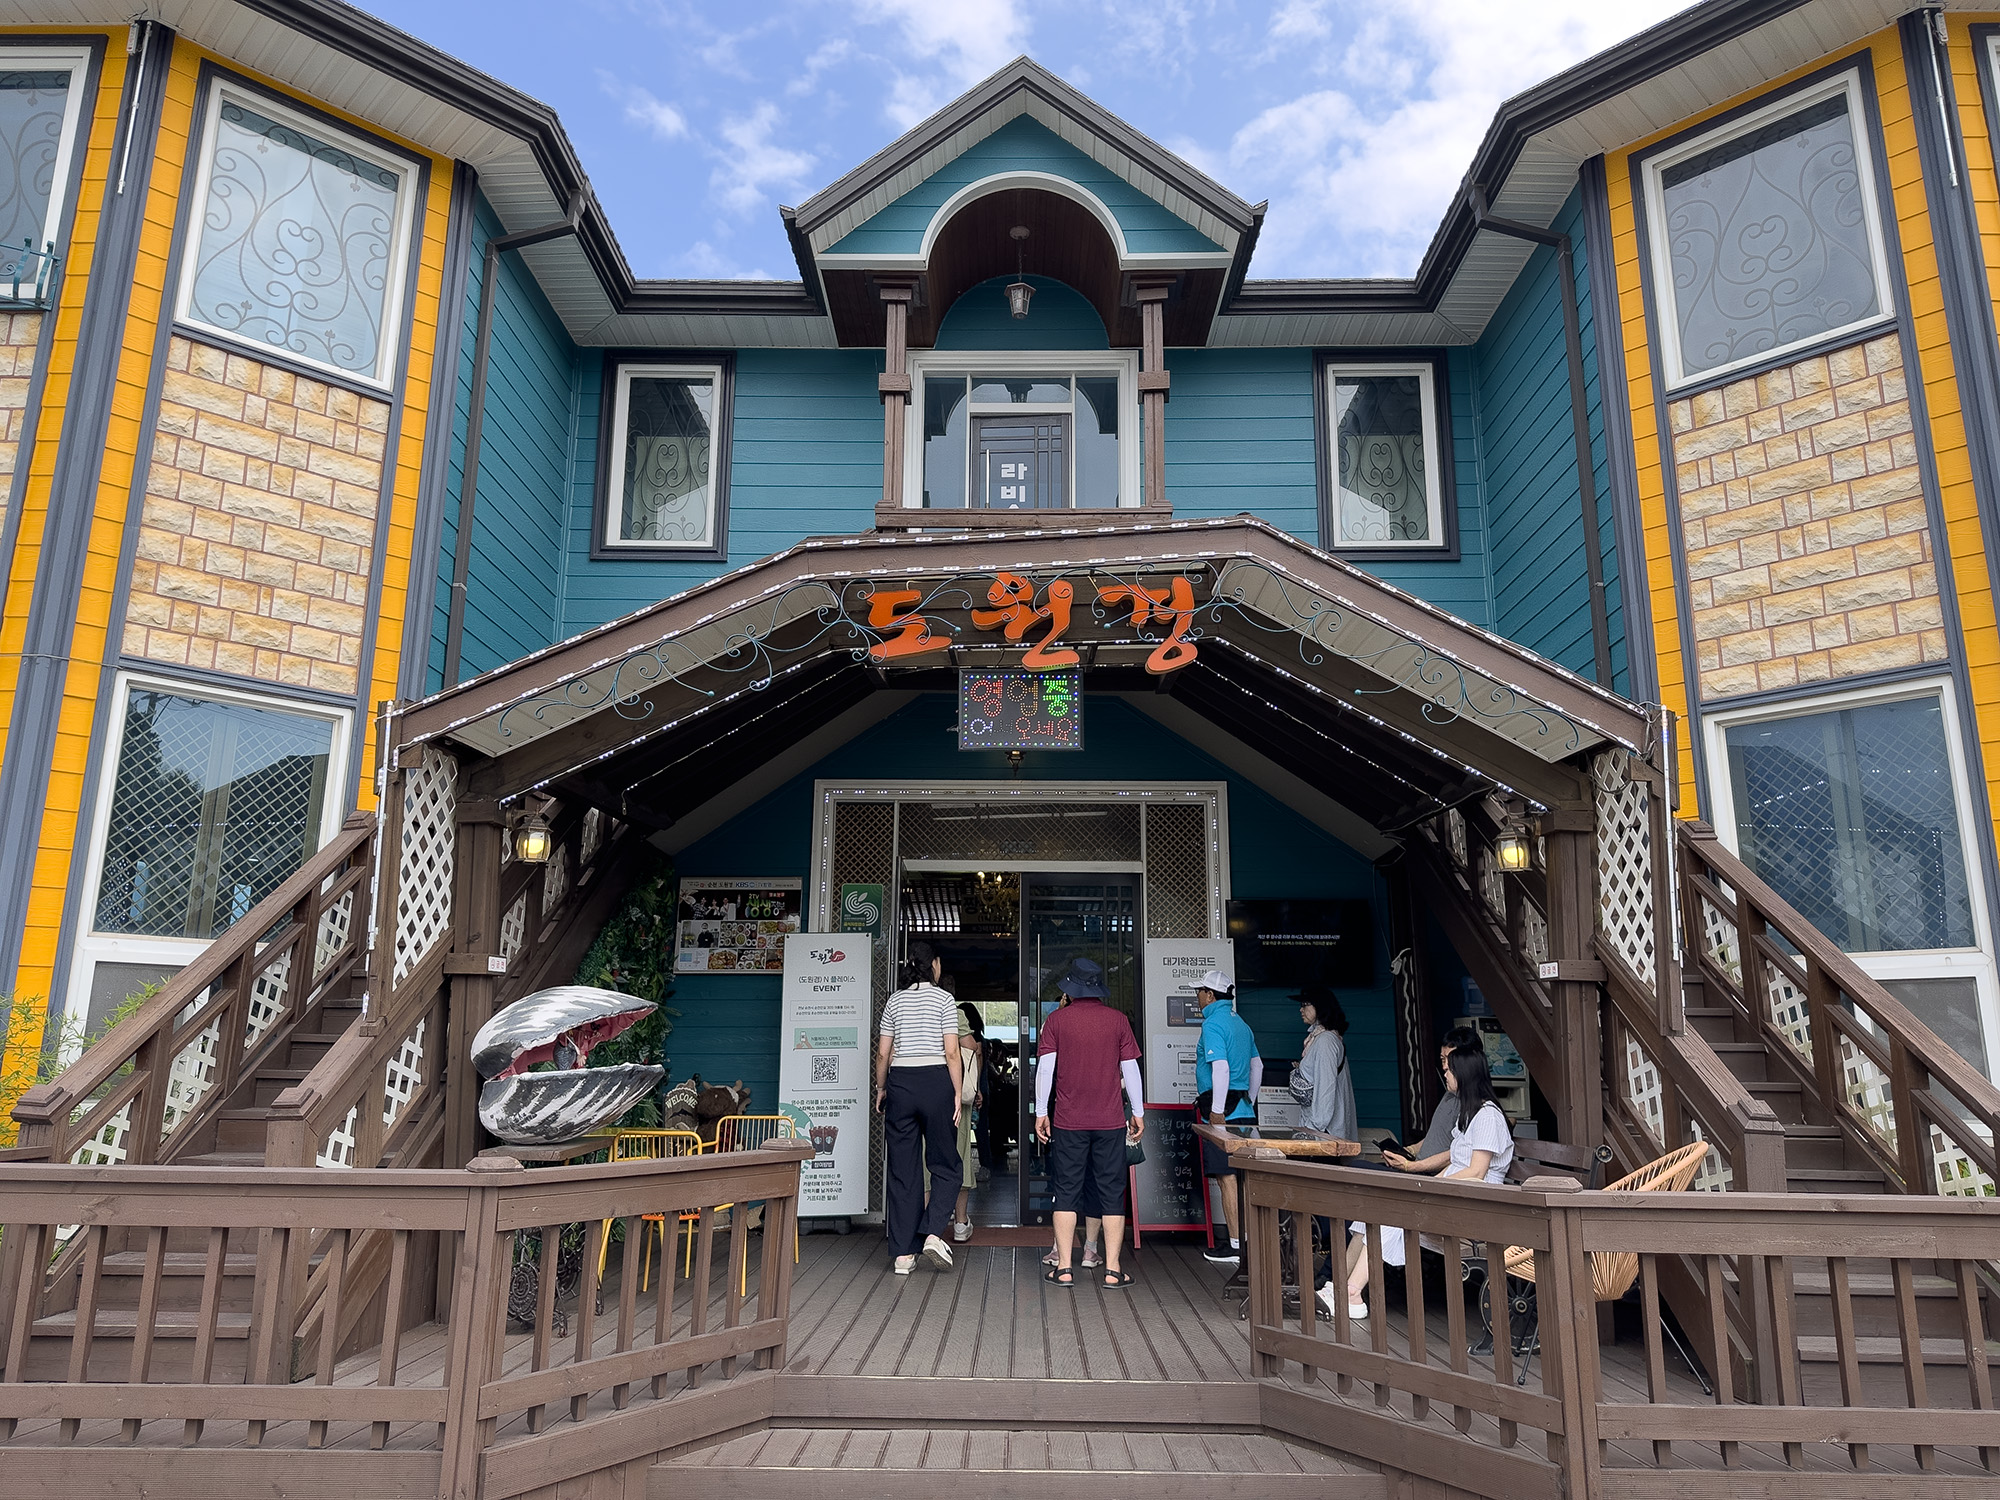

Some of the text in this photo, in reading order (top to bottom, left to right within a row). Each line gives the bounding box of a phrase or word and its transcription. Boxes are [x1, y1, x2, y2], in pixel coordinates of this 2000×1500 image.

[866, 571, 1198, 675] 도원경
[970, 679, 1072, 718] 영업중
[1162, 956, 1216, 966] 대기확정코드
[798, 975, 822, 984] (도원경)
[831, 975, 856, 983] 플레이스
[665, 1092, 698, 1109] WELCOME
